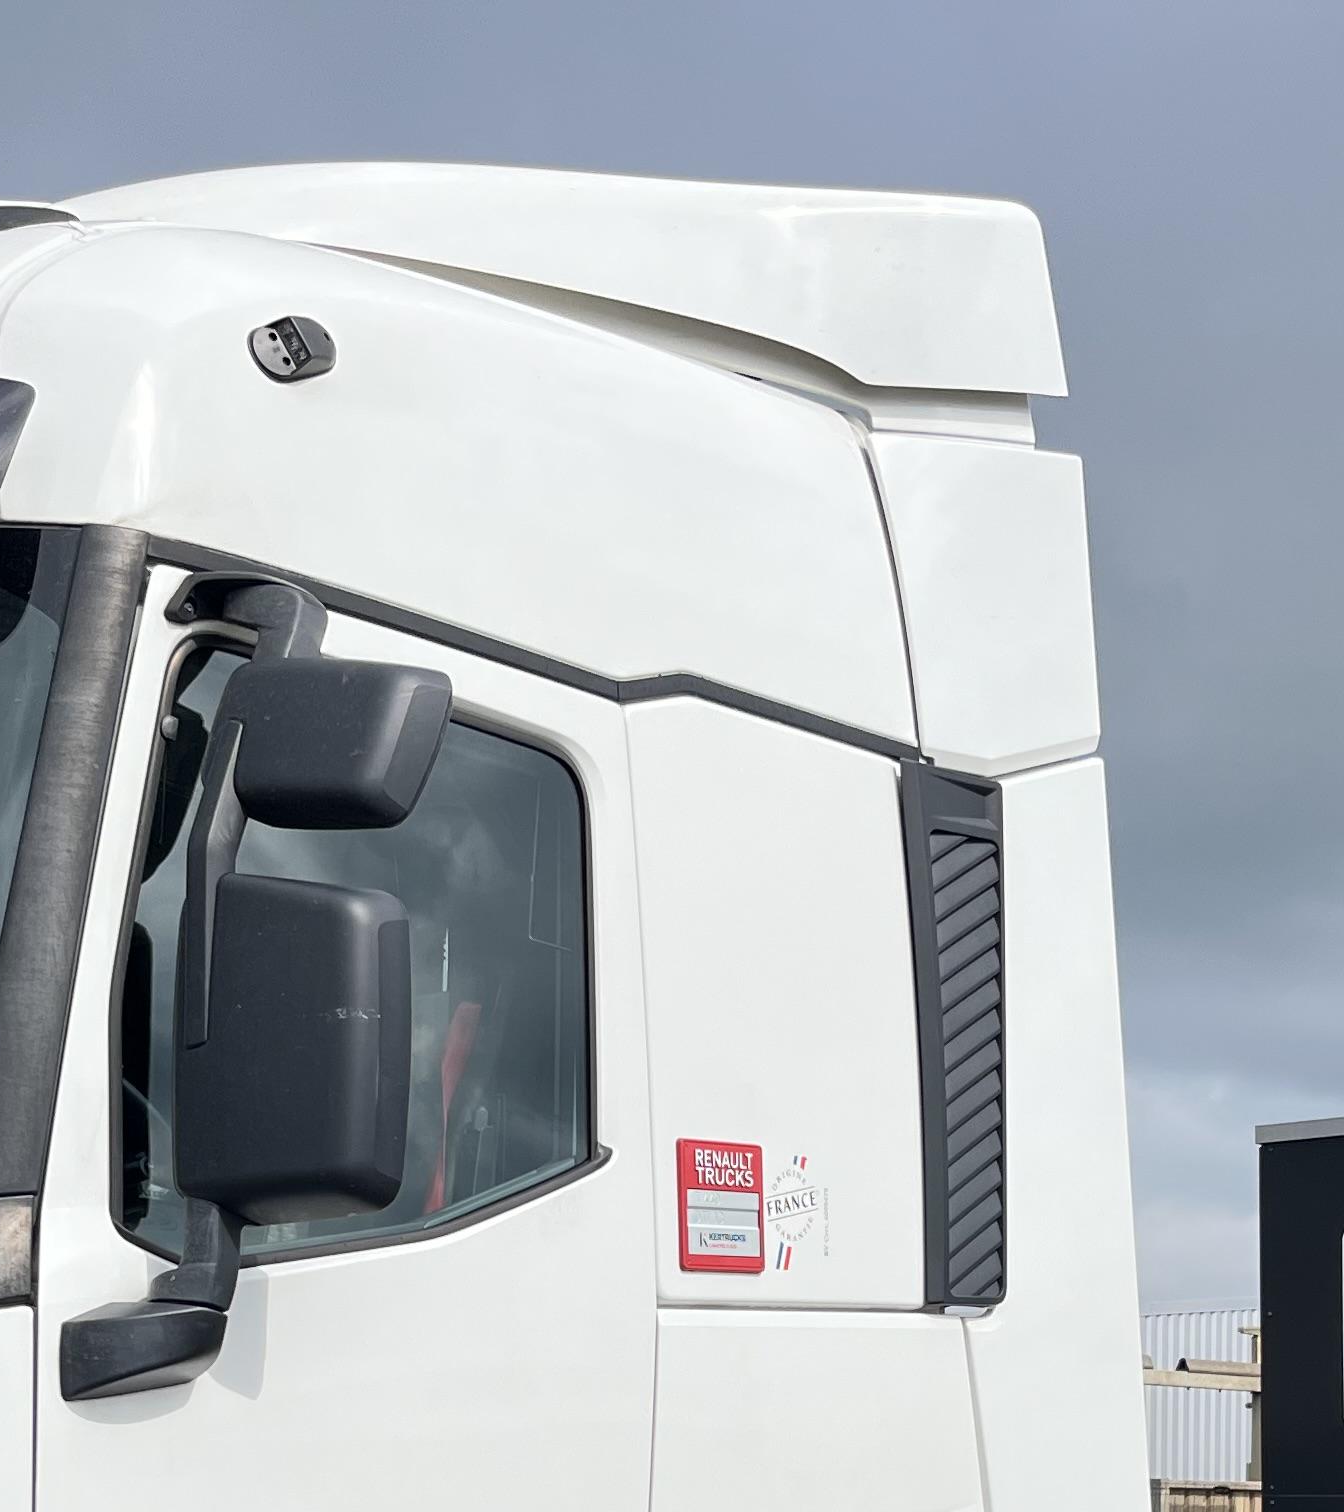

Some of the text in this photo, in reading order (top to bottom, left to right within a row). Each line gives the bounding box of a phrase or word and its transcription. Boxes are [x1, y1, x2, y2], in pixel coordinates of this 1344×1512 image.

[694, 1148, 754, 1171] RENAULT
[695, 1167, 755, 1188] TRUCKS
[766, 1191, 817, 1217] FRANCE
